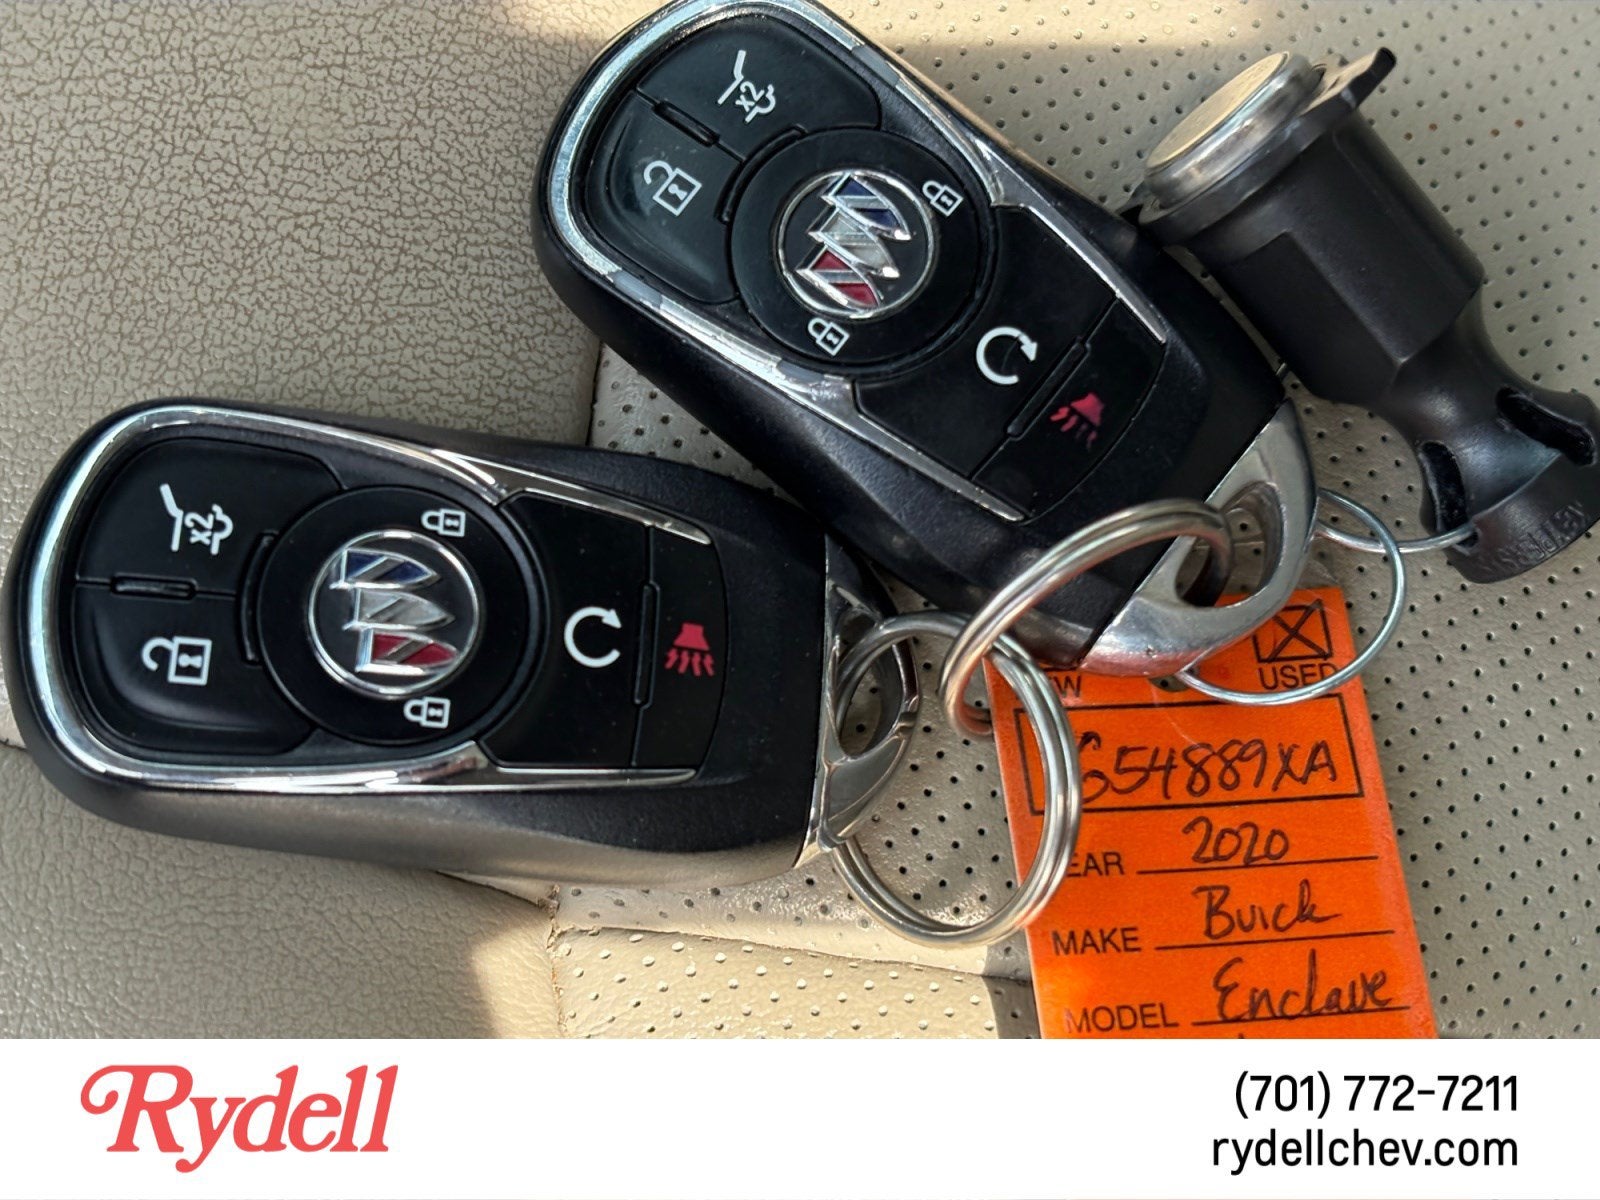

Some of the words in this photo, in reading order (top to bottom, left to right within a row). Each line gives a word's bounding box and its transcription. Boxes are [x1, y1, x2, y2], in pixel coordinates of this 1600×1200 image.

[1258, 662, 1340, 690] USED
[1181, 816, 1289, 866] 2020
[1066, 851, 1125, 877] EAR
[1191, 879, 1342, 940] Buick
[1051, 926, 1142, 956] MAKE
[1212, 949, 1394, 1022] Enclave
[1064, 1002, 1180, 1034] MODEL
